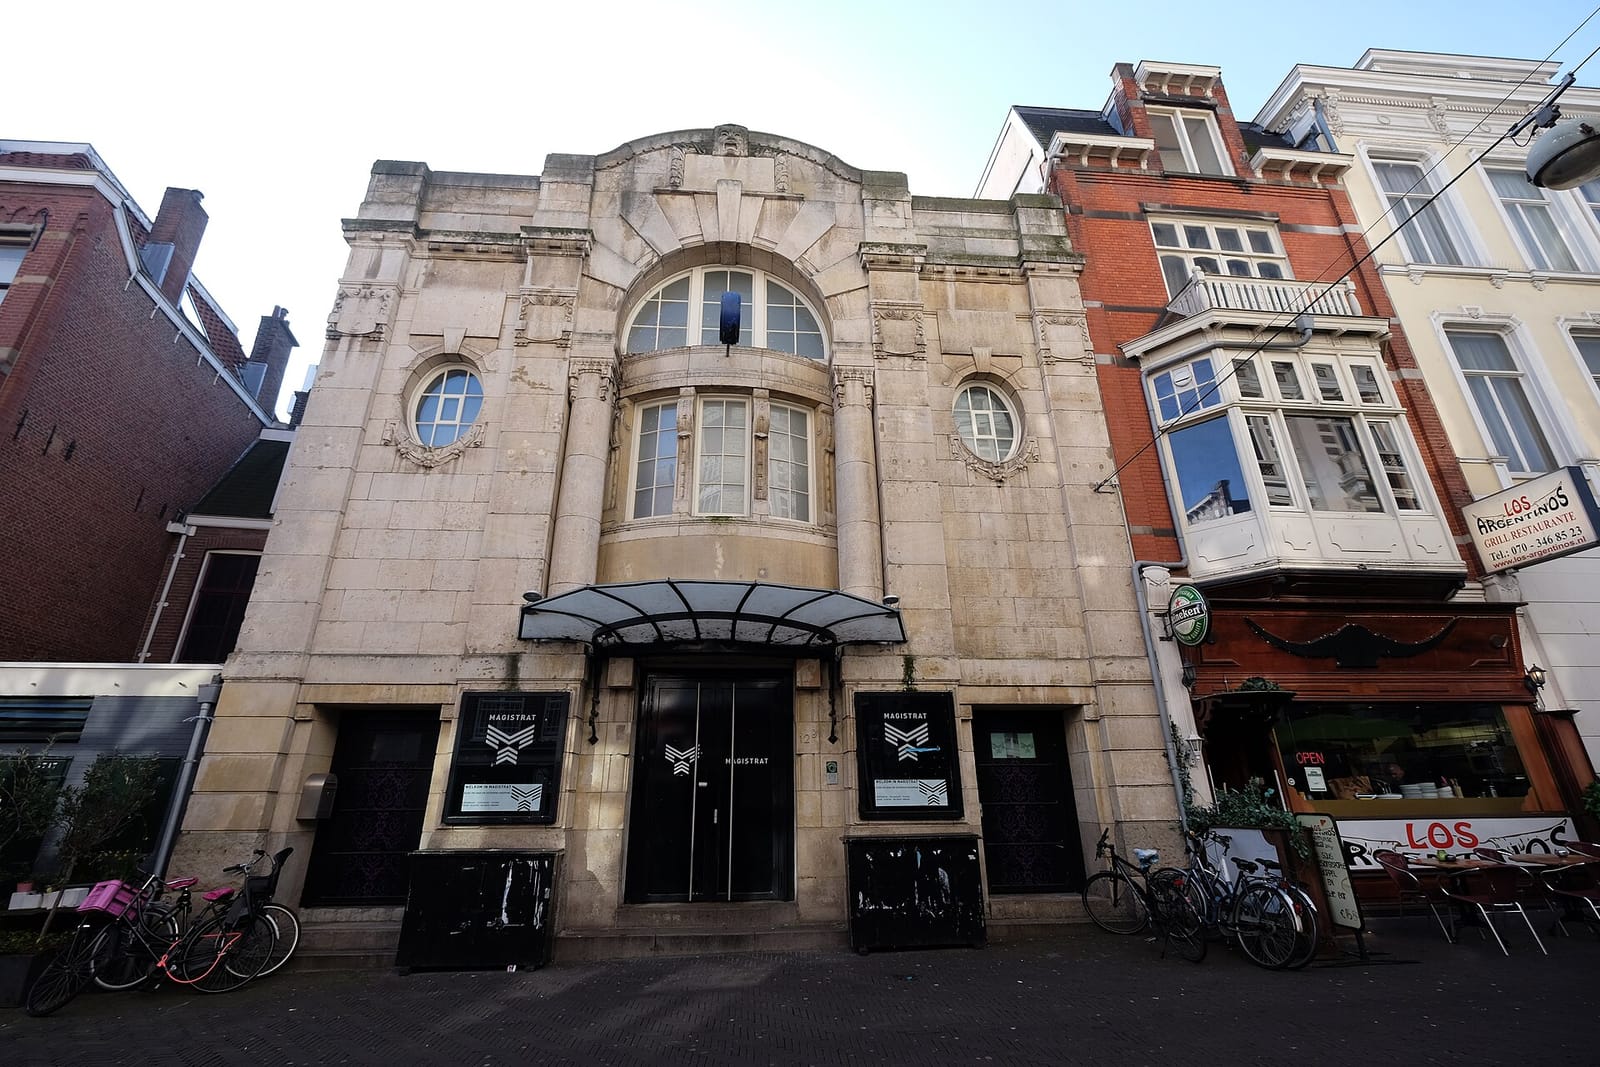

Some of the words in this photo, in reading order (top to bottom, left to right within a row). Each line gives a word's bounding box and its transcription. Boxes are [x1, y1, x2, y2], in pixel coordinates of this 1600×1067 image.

[1477, 486, 1569, 535] ARGENTINOS
[1504, 496, 1531, 517] LOS
[1484, 533, 1510, 548] GRILL
[1510, 511, 1576, 539] RESTAURANTE
[1489, 550, 1509, 561] Tel.:
[1511, 543, 1528, 555] 070
[1536, 536, 1554, 548] 346
[1554, 530, 1568, 541] 85
[1569, 525, 1583, 537] 23
[1492, 535, 1587, 569] www.los-argentinos.nl
[883, 712, 927, 720] MAGISTRAT
[1295, 751, 1325, 764] OPEN
[1405, 821, 1479, 849] LOS
